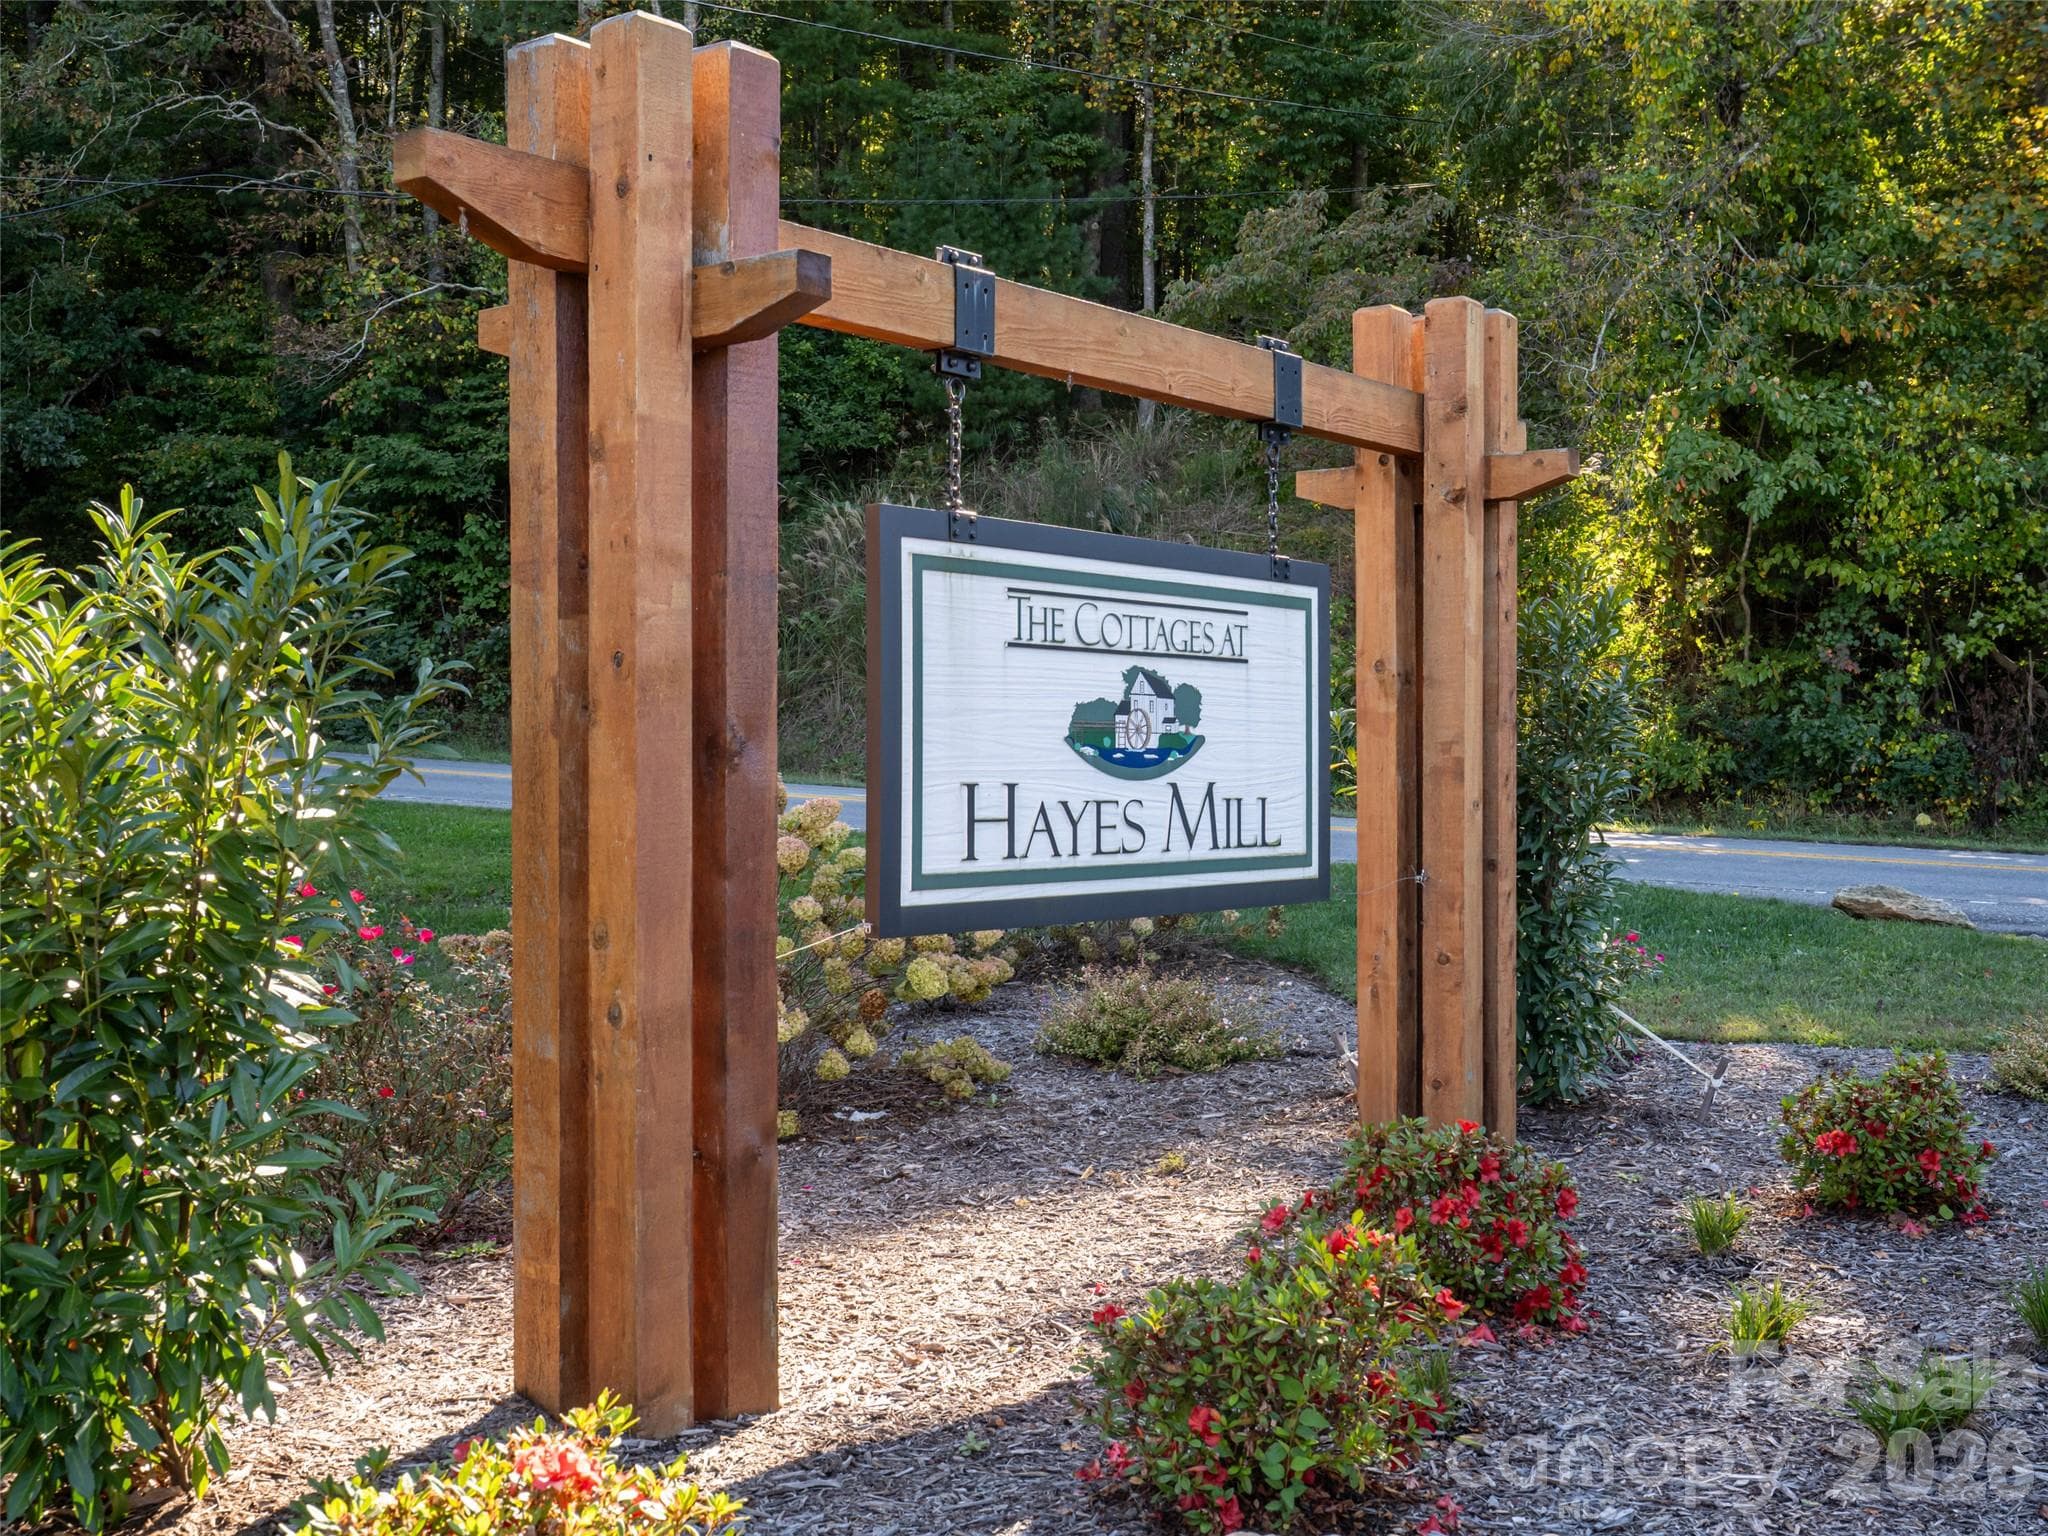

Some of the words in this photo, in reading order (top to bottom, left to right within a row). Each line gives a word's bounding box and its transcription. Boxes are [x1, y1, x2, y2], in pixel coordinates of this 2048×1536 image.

[1007, 595, 1066, 644] THE
[1074, 602, 1215, 655] COTTAGES
[1218, 624, 1249, 658] AT
[960, 782, 1147, 862] HAYES
[1161, 781, 1282, 853] MILL
